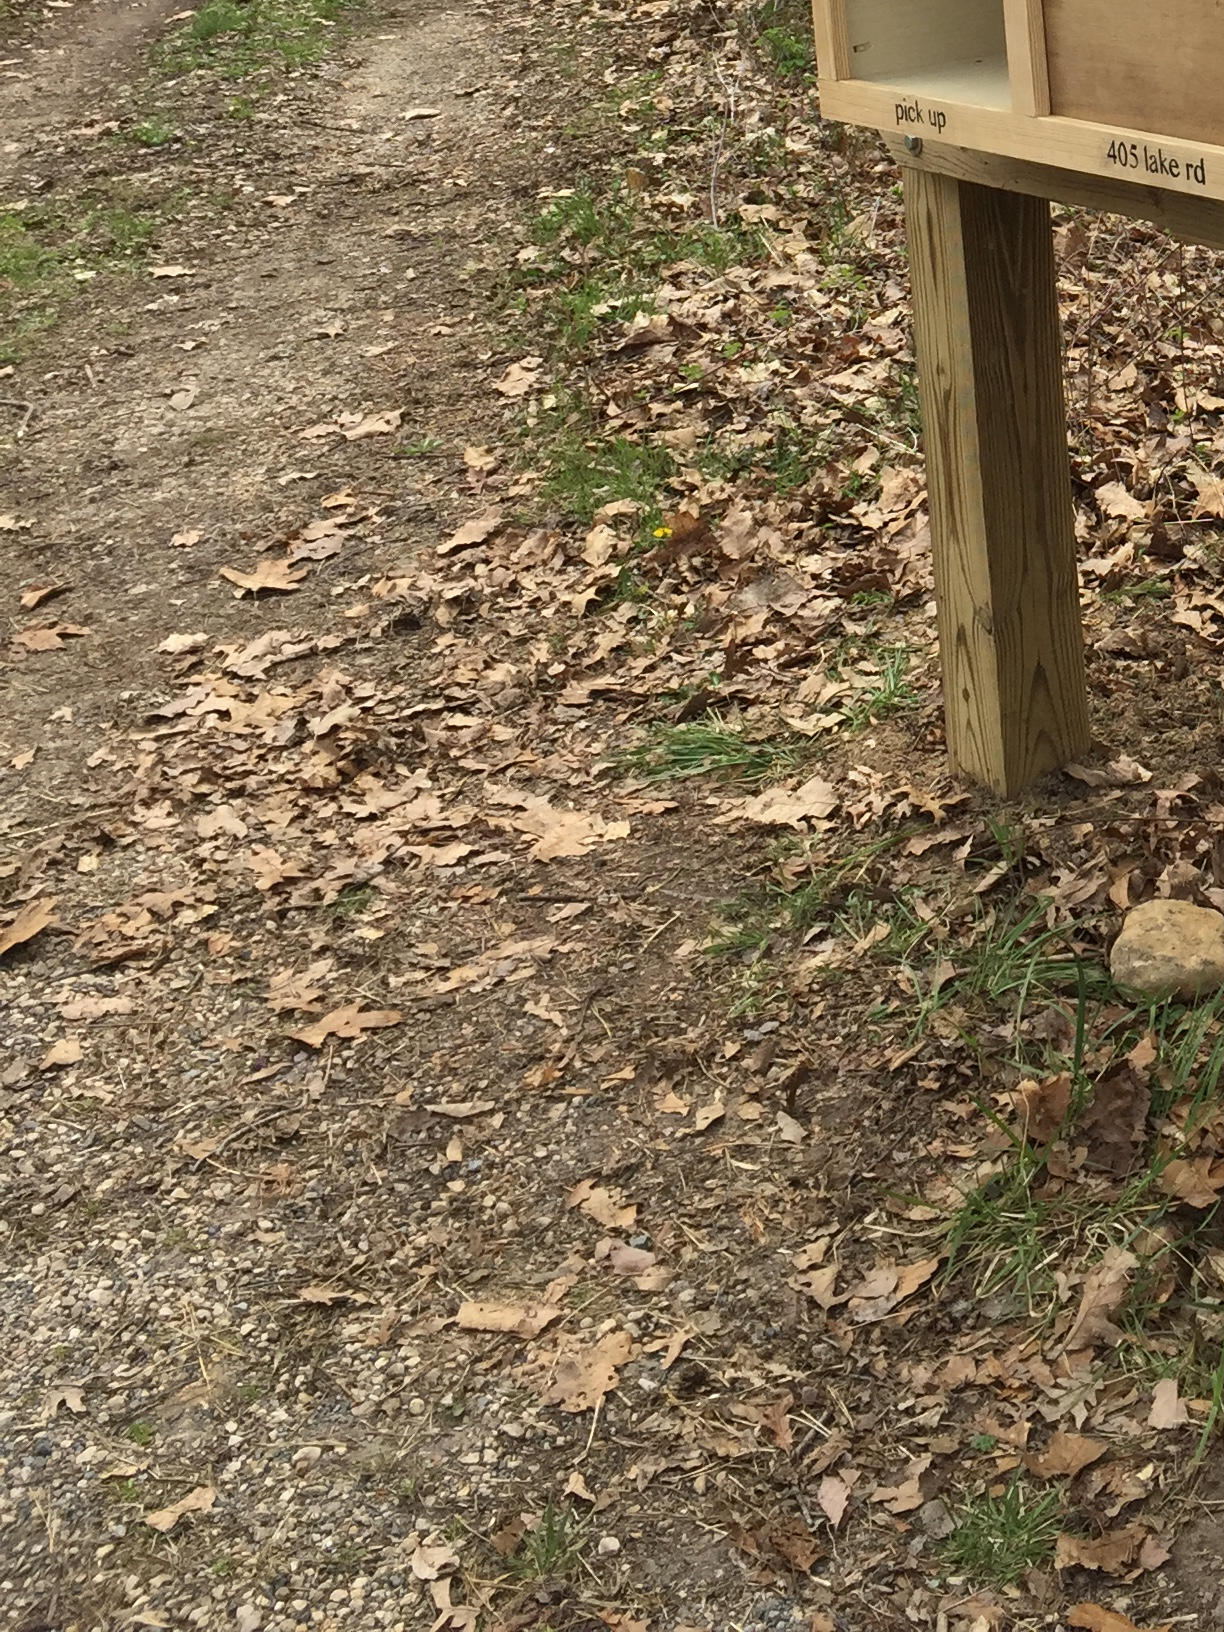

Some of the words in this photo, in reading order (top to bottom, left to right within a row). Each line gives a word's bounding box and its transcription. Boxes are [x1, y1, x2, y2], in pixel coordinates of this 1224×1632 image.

[895, 97, 925, 126] pick
[928, 108, 947, 134] up
[1107, 139, 1139, 169] 405
[1143, 144, 1181, 178] lake
[1185, 157, 1206, 185] rd
